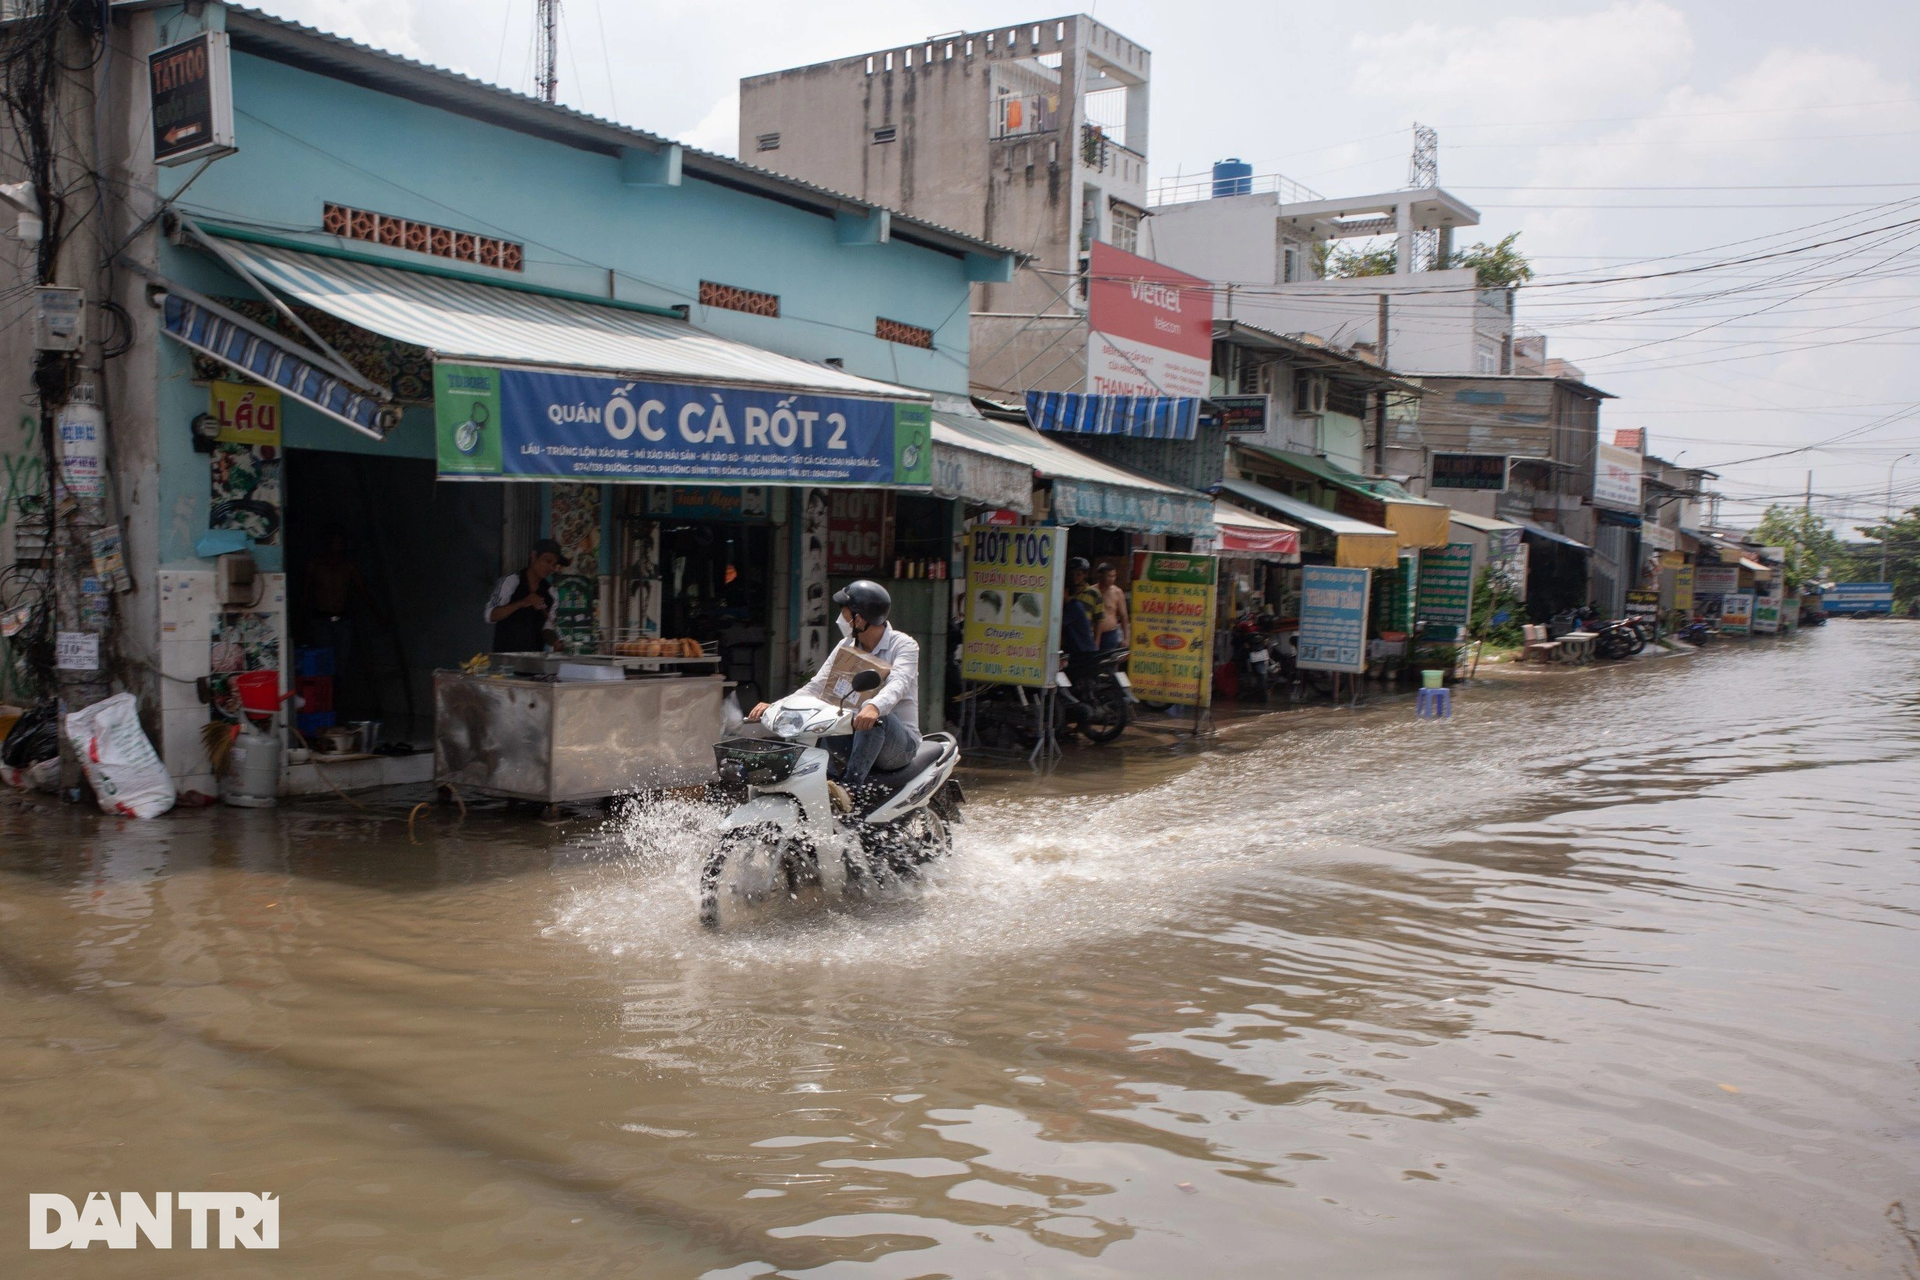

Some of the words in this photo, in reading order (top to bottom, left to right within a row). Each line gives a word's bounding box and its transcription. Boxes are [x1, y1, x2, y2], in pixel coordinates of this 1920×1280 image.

[153, 45, 205, 95] TATTOO
[1129, 275, 1181, 313] Viettel
[218, 391, 276, 431] LẨU
[548, 402, 601, 425] QUÁN
[604, 383, 667, 441] ỐC
[678, 393, 736, 445] CÀ
[744, 396, 820, 448] RỐT
[826, 412, 848, 450] 2
[1014, 528, 1051, 568] TÓC
